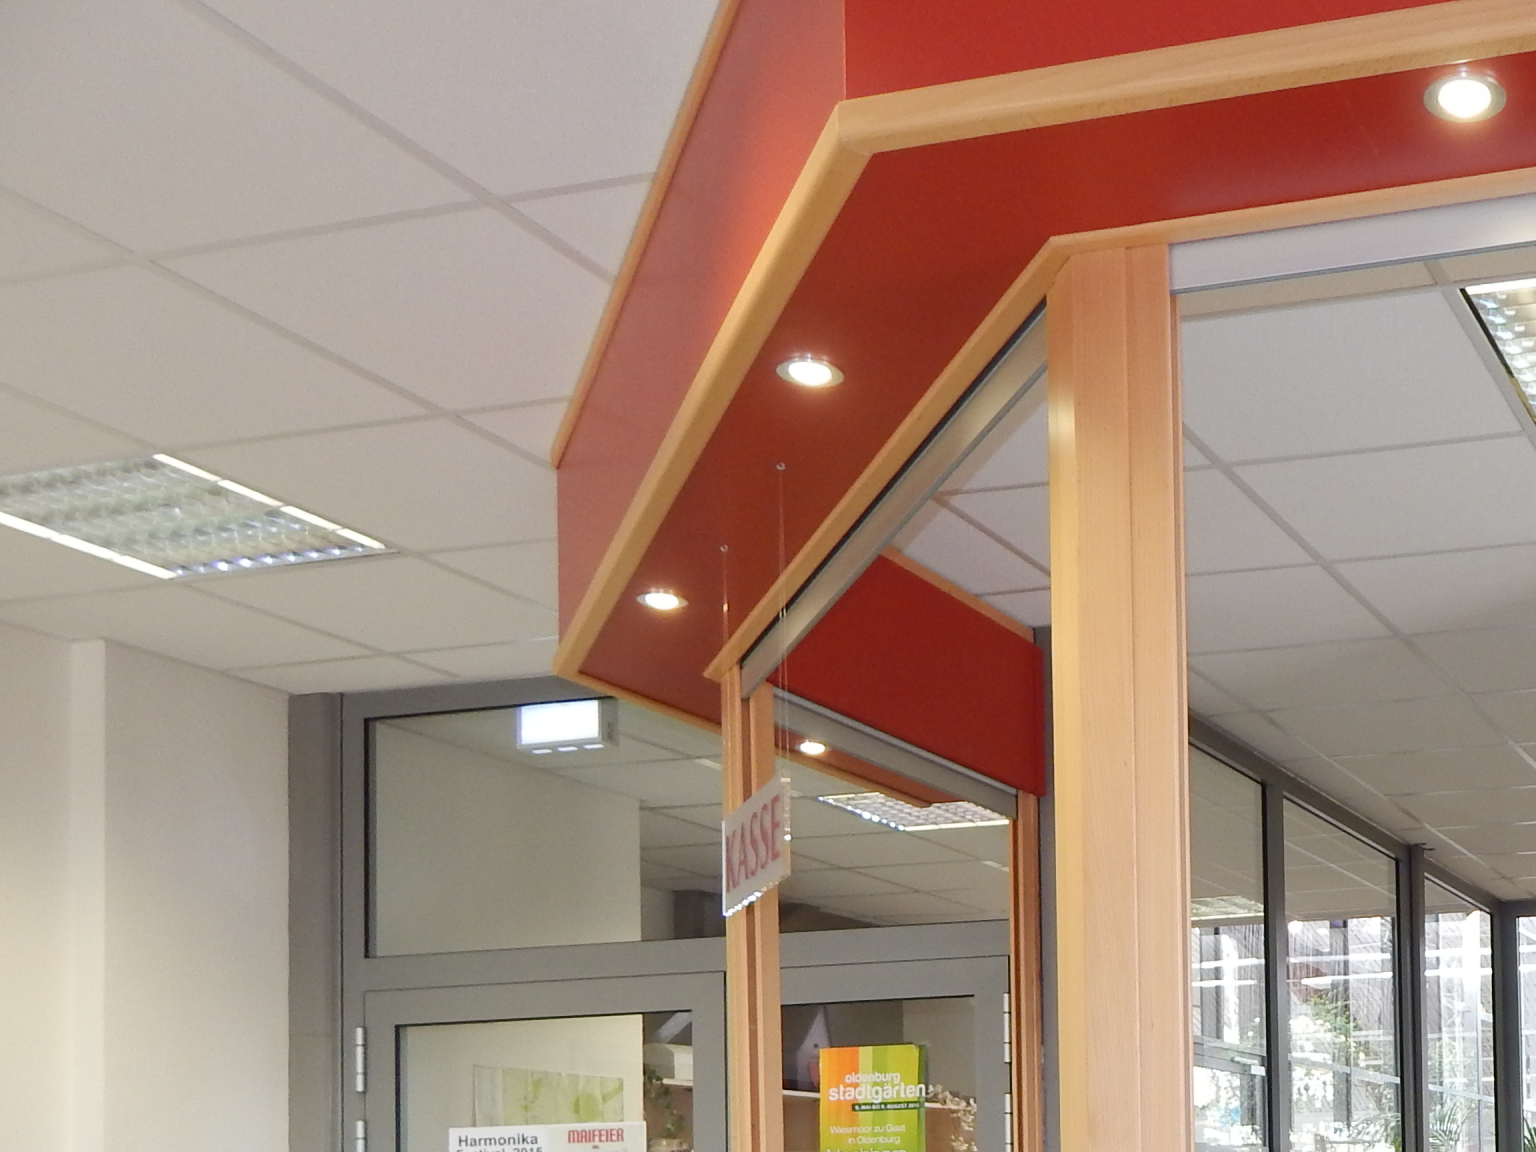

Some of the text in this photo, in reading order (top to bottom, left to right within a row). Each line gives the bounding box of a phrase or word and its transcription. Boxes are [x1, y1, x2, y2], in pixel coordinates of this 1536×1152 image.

[726, 795, 780, 893] KASSE
[845, 1072, 900, 1084] oldenburg
[828, 1083, 926, 1103] stadtgärten
[568, 1128, 624, 1143] MAIFEIER
[830, 1125, 872, 1134] Wiesmoor
[885, 1124, 906, 1132] Gast
[458, 1133, 538, 1146] Harmonika
[857, 1135, 900, 1145] Oldenburg
